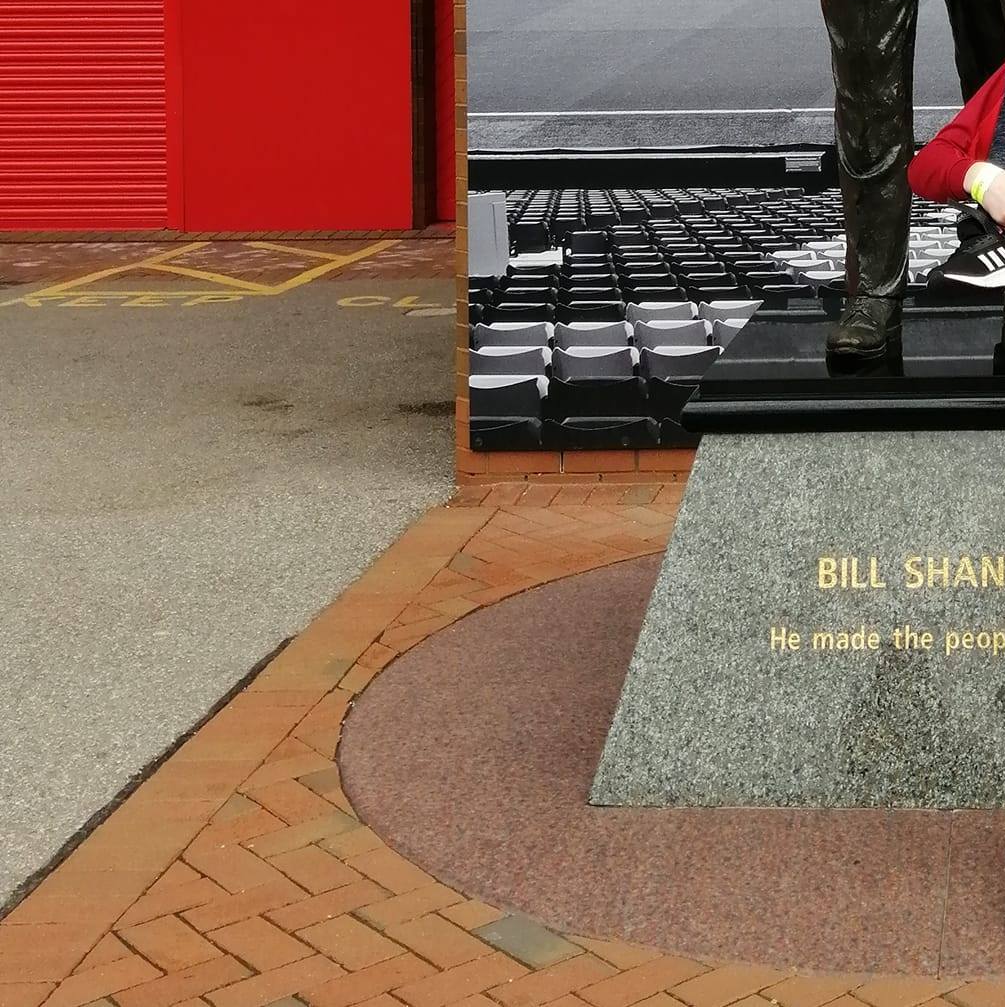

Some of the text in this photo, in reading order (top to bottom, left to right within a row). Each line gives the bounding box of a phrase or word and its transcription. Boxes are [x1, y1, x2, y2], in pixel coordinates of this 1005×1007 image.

[817, 555, 887, 589] BILL
[770, 626, 800, 651] He
[812, 625, 880, 650] made
[893, 624, 933, 650] the
